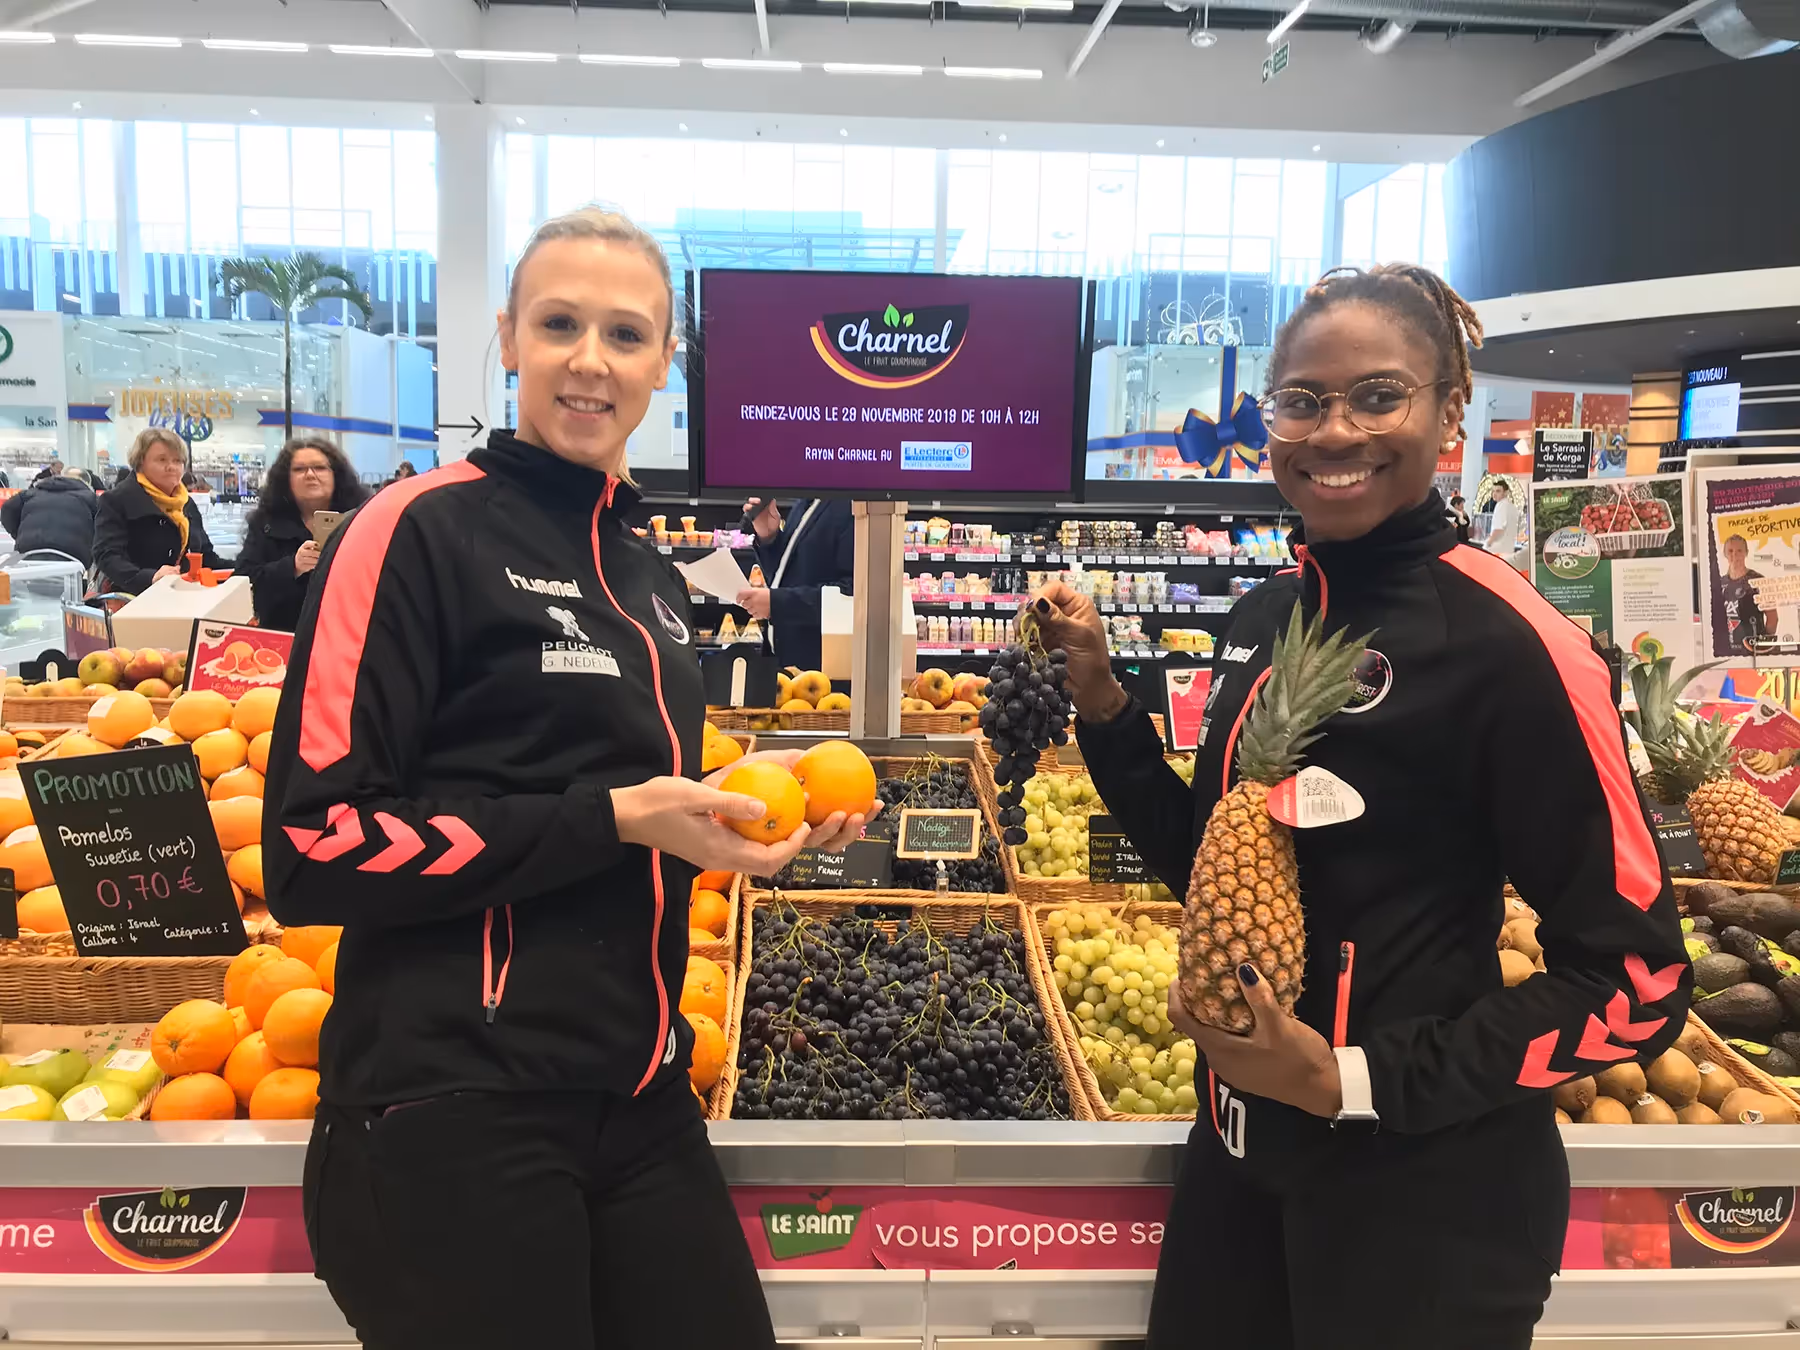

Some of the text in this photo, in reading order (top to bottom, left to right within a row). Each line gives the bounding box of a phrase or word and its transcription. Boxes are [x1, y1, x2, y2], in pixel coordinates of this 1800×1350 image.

[838, 319, 952, 353] Charnel
[119, 387, 234, 419] JOYEUSES
[740, 404, 1039, 425] RENDEZ-VOUS LE 28 NOVEMBRE 2018 DE 10H À 12H
[1540, 443, 1586, 453] Le Sarrasin
[1543, 452, 1554, 462] de
[1556, 452, 1582, 464] Kerga
[1551, 496, 1568, 504] SAINT
[1728, 514, 1770, 527] PAROLE DE
[1557, 538, 1581, 549] local
[505, 567, 583, 598] hummel
[542, 641, 613, 659] PEUGEOT
[33, 762, 195, 804] PROMOTION
[58, 822, 133, 846] Pomelos
[1674, 829, 1692, 838] POINT
[148, 835, 196, 863] (vert)
[1120, 838, 1134, 848] RA
[817, 853, 845, 864] MUSCAT
[817, 865, 844, 877] FRANCE
[97, 866, 203, 910] 0,70 €
[127, 917, 160, 930] Israel
[222, 922, 229, 933] I
[82, 934, 138, 947] Calibre 4
[112, 1200, 229, 1234] Charnel
[772, 1213, 855, 1235] LE SAINT
[876, 1223, 959, 1248] vous
[973, 1221, 1117, 1256] propose
